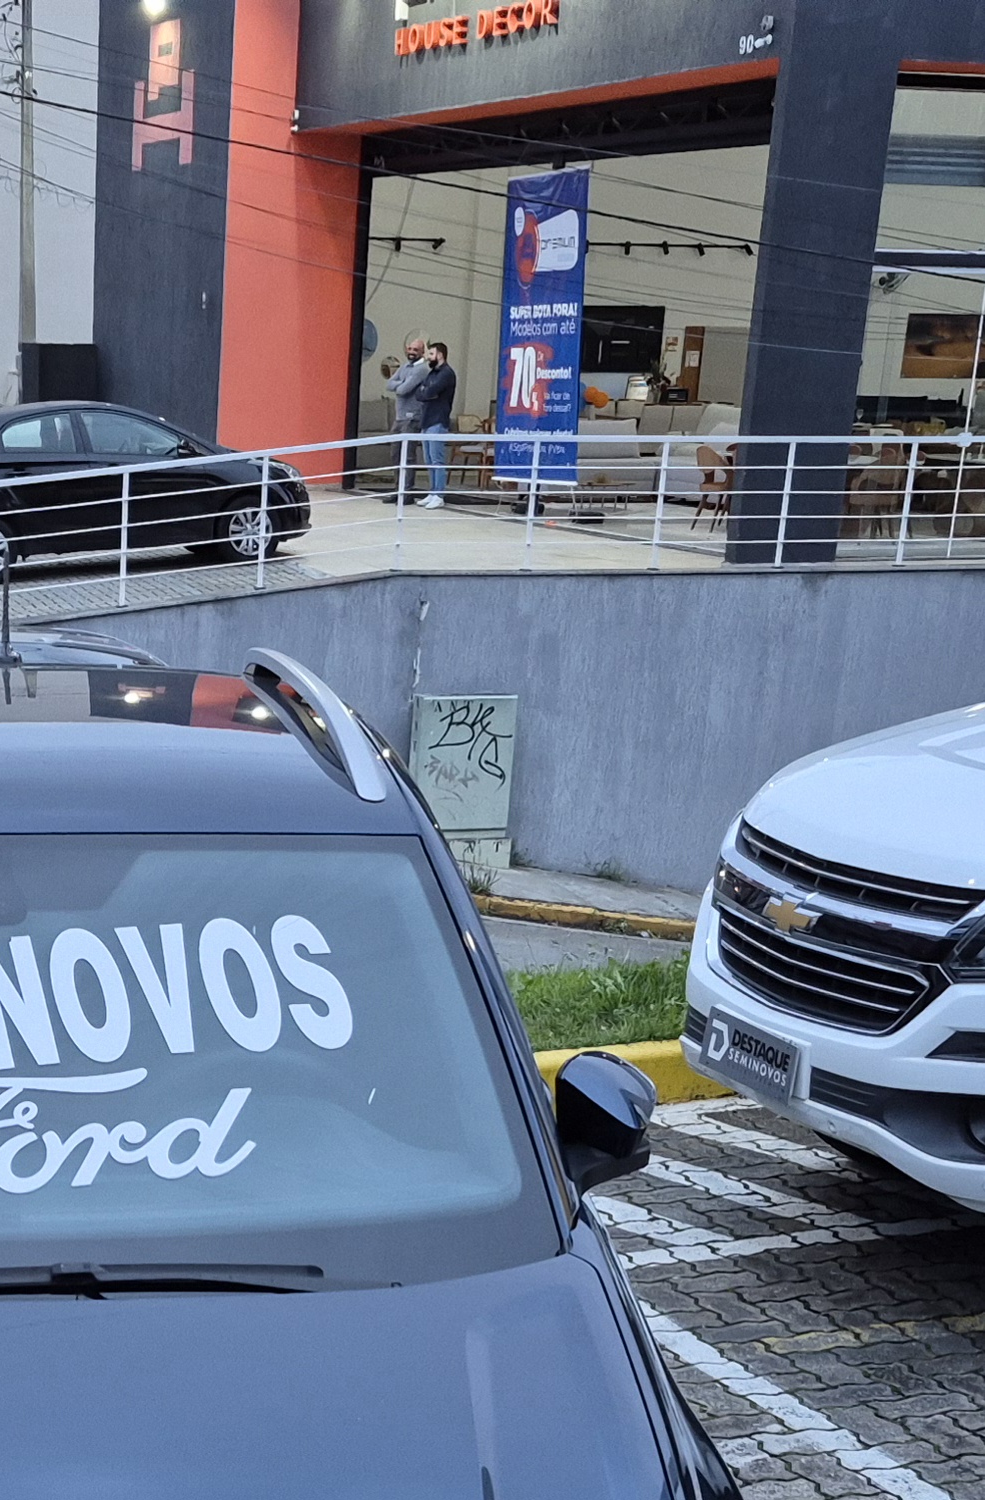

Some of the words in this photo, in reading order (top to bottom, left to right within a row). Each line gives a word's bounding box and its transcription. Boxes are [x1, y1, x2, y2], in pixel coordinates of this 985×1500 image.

[395, 15, 470, 56] HOUSE
[476, 0, 561, 39] DECOR
[510, 305, 532, 319] SUPER
[532, 304, 552, 319] BOTA
[552, 302, 578, 317] FORA!
[510, 321, 541, 337] Modelos
[542, 323, 558, 335] com
[559, 318, 576, 335] até
[536, 367, 572, 380] Desconto!
[731, 1028, 791, 1073] DESTAQUE
[727, 1047, 788, 1087] SEMINOVOS
